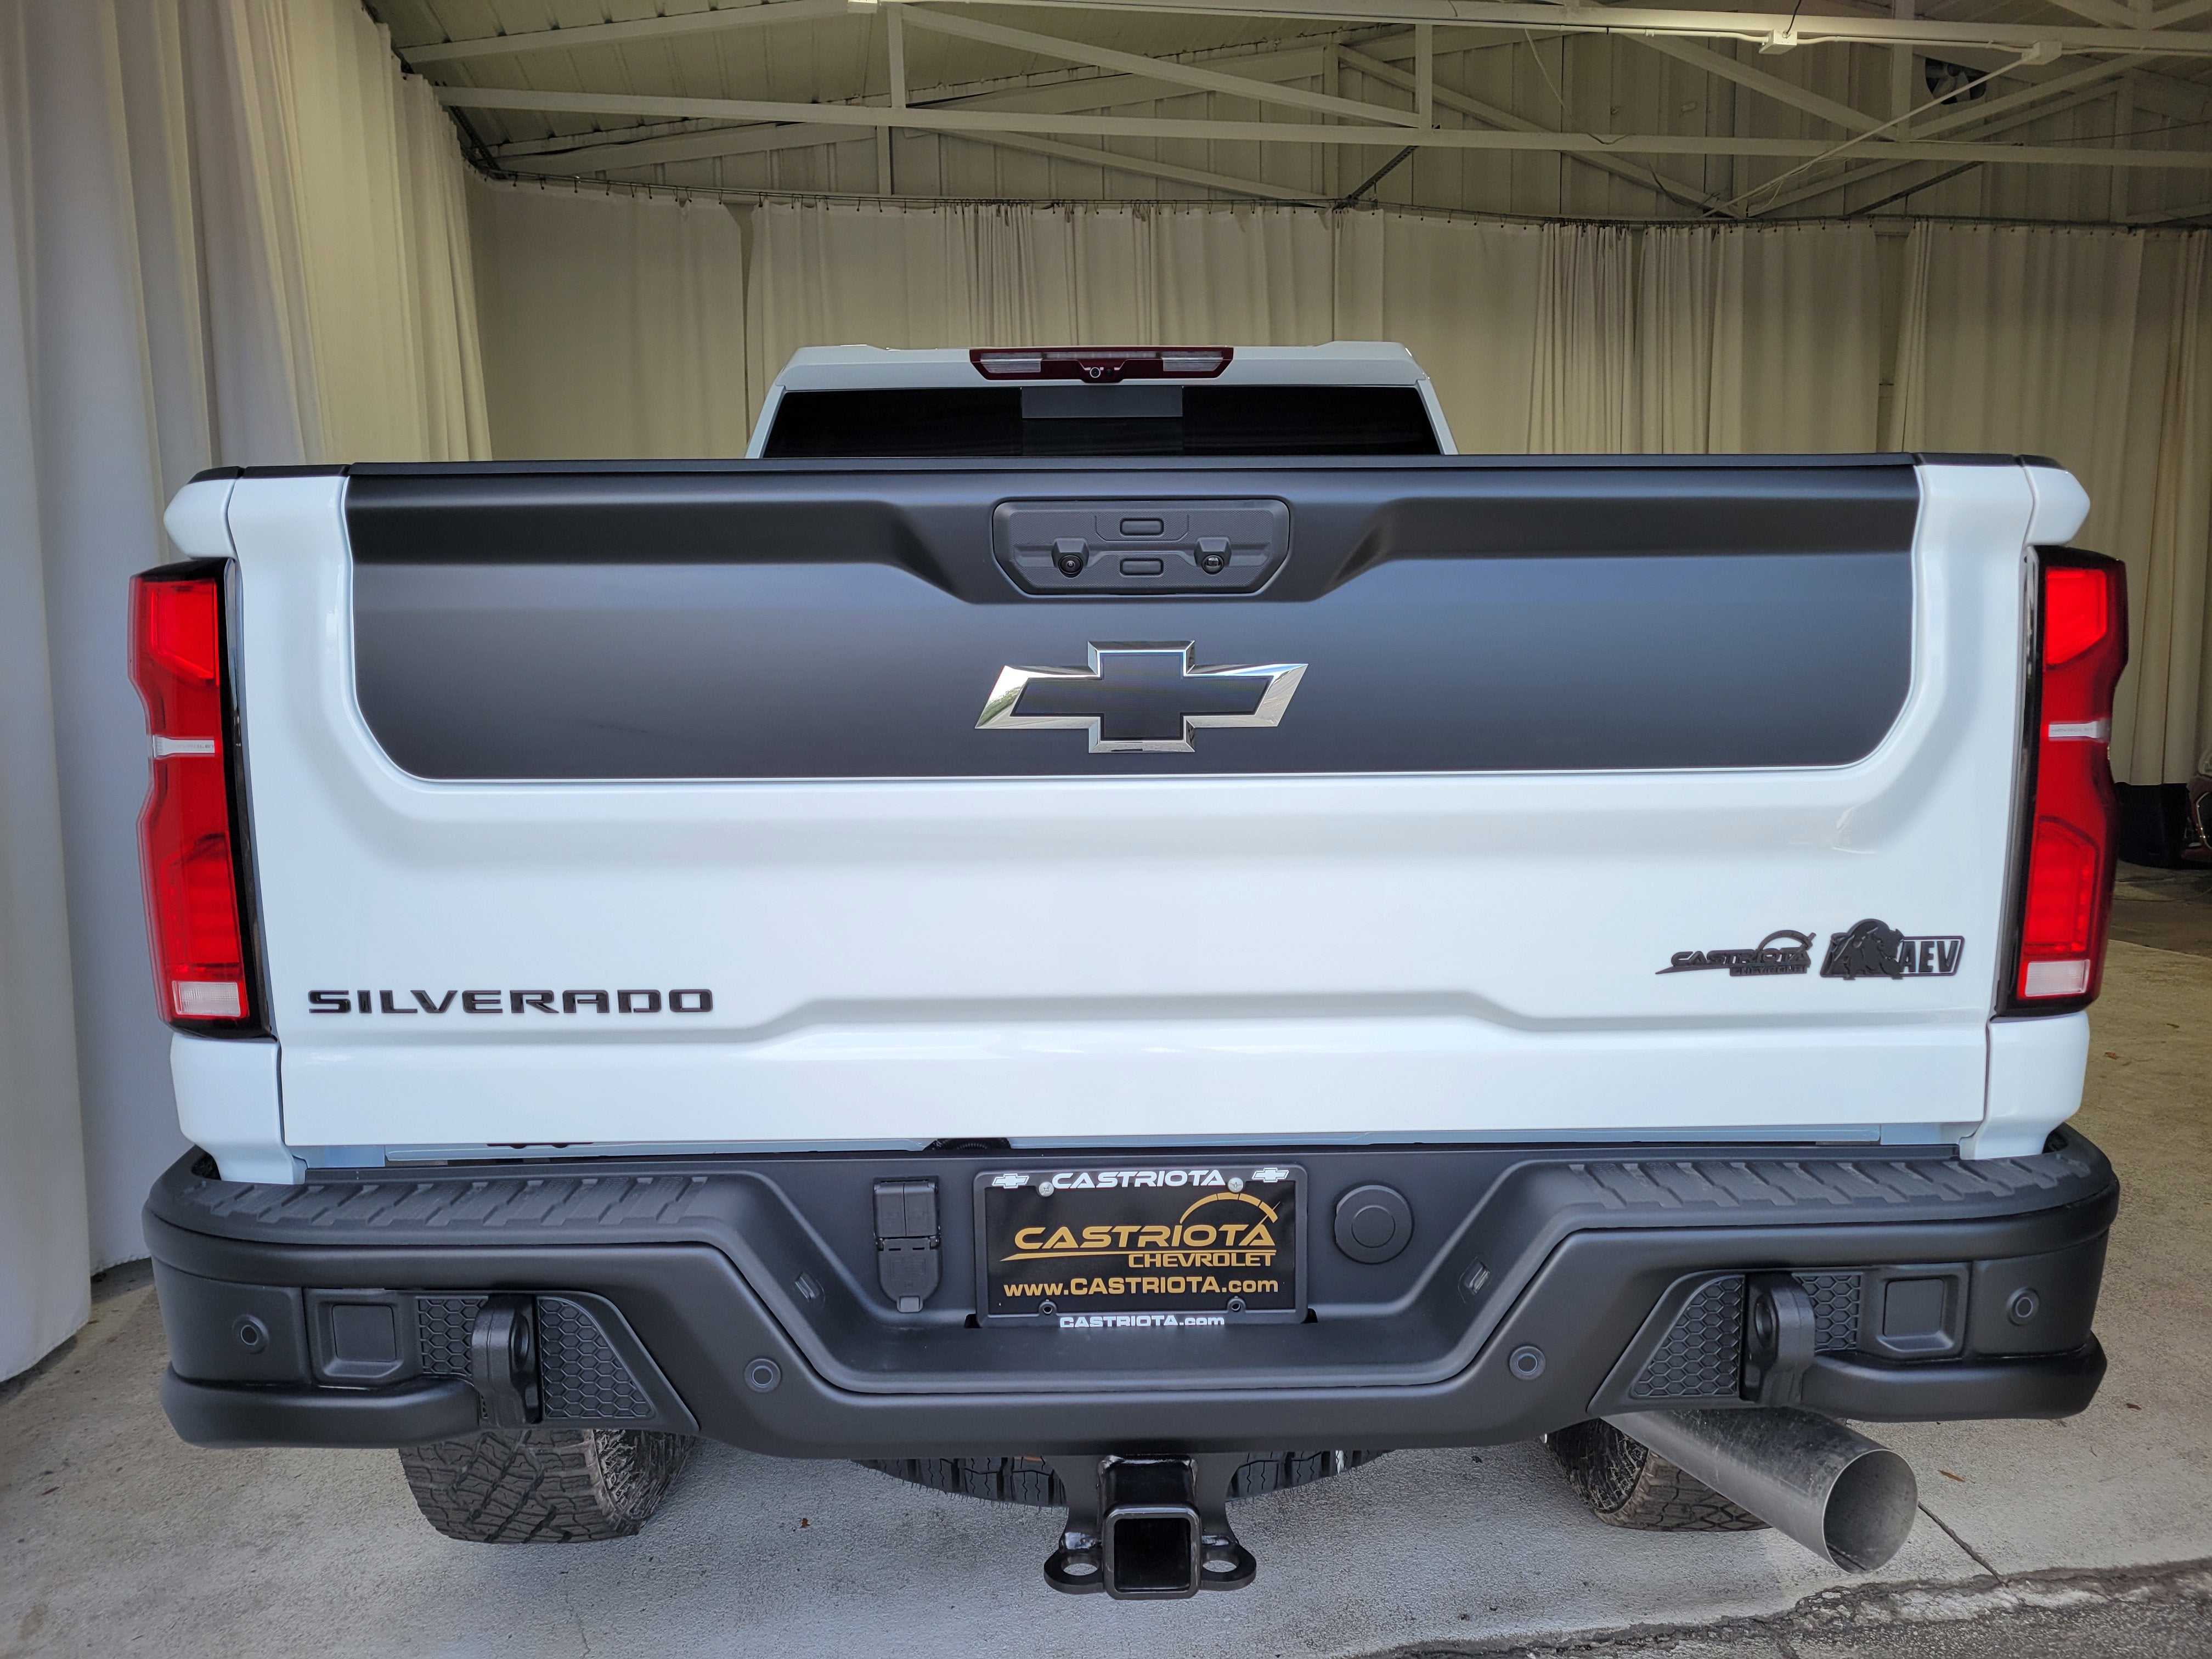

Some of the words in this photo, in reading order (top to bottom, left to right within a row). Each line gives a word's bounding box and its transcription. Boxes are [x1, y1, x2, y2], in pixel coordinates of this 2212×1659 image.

[1671, 947, 1810, 968] CASTRIOTA
[1900, 940, 1959, 973] AEV
[308, 989, 714, 1014] SILVERADO
[1052, 1170, 1226, 1189] CASTRIOTA
[1014, 1224, 1276, 1249] CASTRIOTA
[1128, 1252, 1277, 1268] CHEVROLET
[1003, 1276, 1279, 1297] www.CASTRIOTA.com
[1059, 1314, 1226, 1328] CASTRIOTA.com
